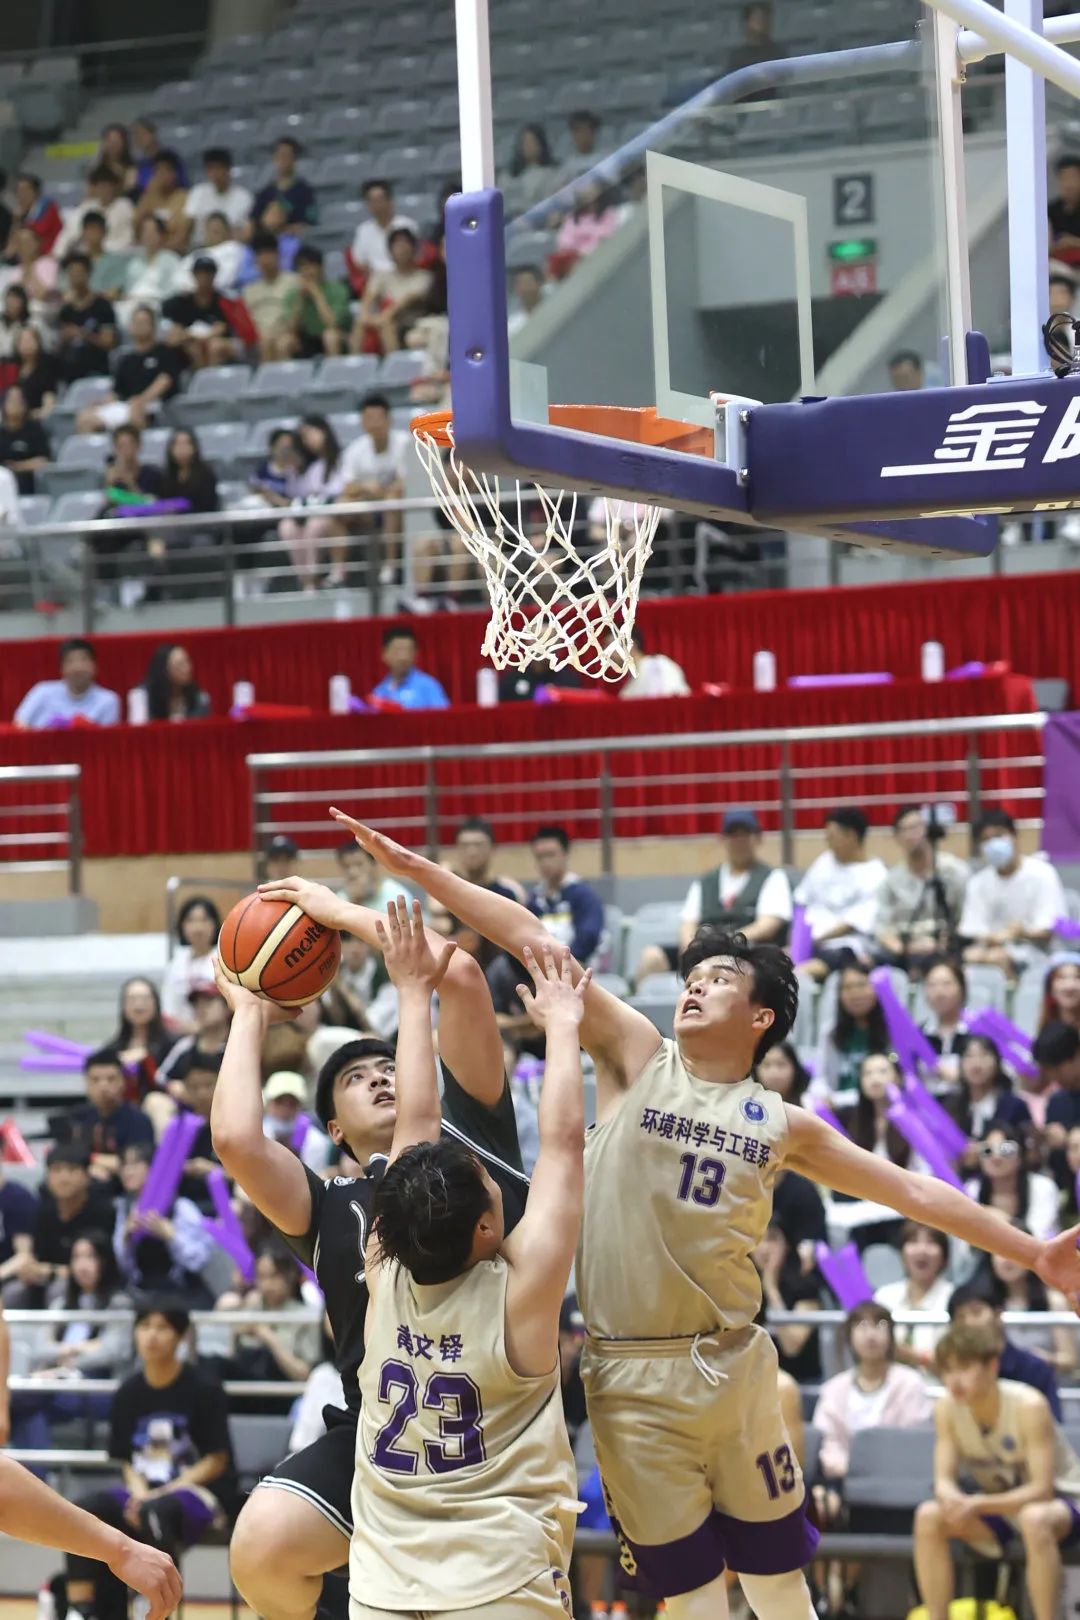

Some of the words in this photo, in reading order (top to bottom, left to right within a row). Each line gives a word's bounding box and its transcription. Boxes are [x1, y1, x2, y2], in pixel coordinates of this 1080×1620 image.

[842, 180, 866, 219] 2
[640, 1107, 771, 1168] 环境科学与工程系
[677, 1151, 726, 1208] 13
[370, 1358, 487, 1476] 23
[756, 1443, 795, 1501] 13
